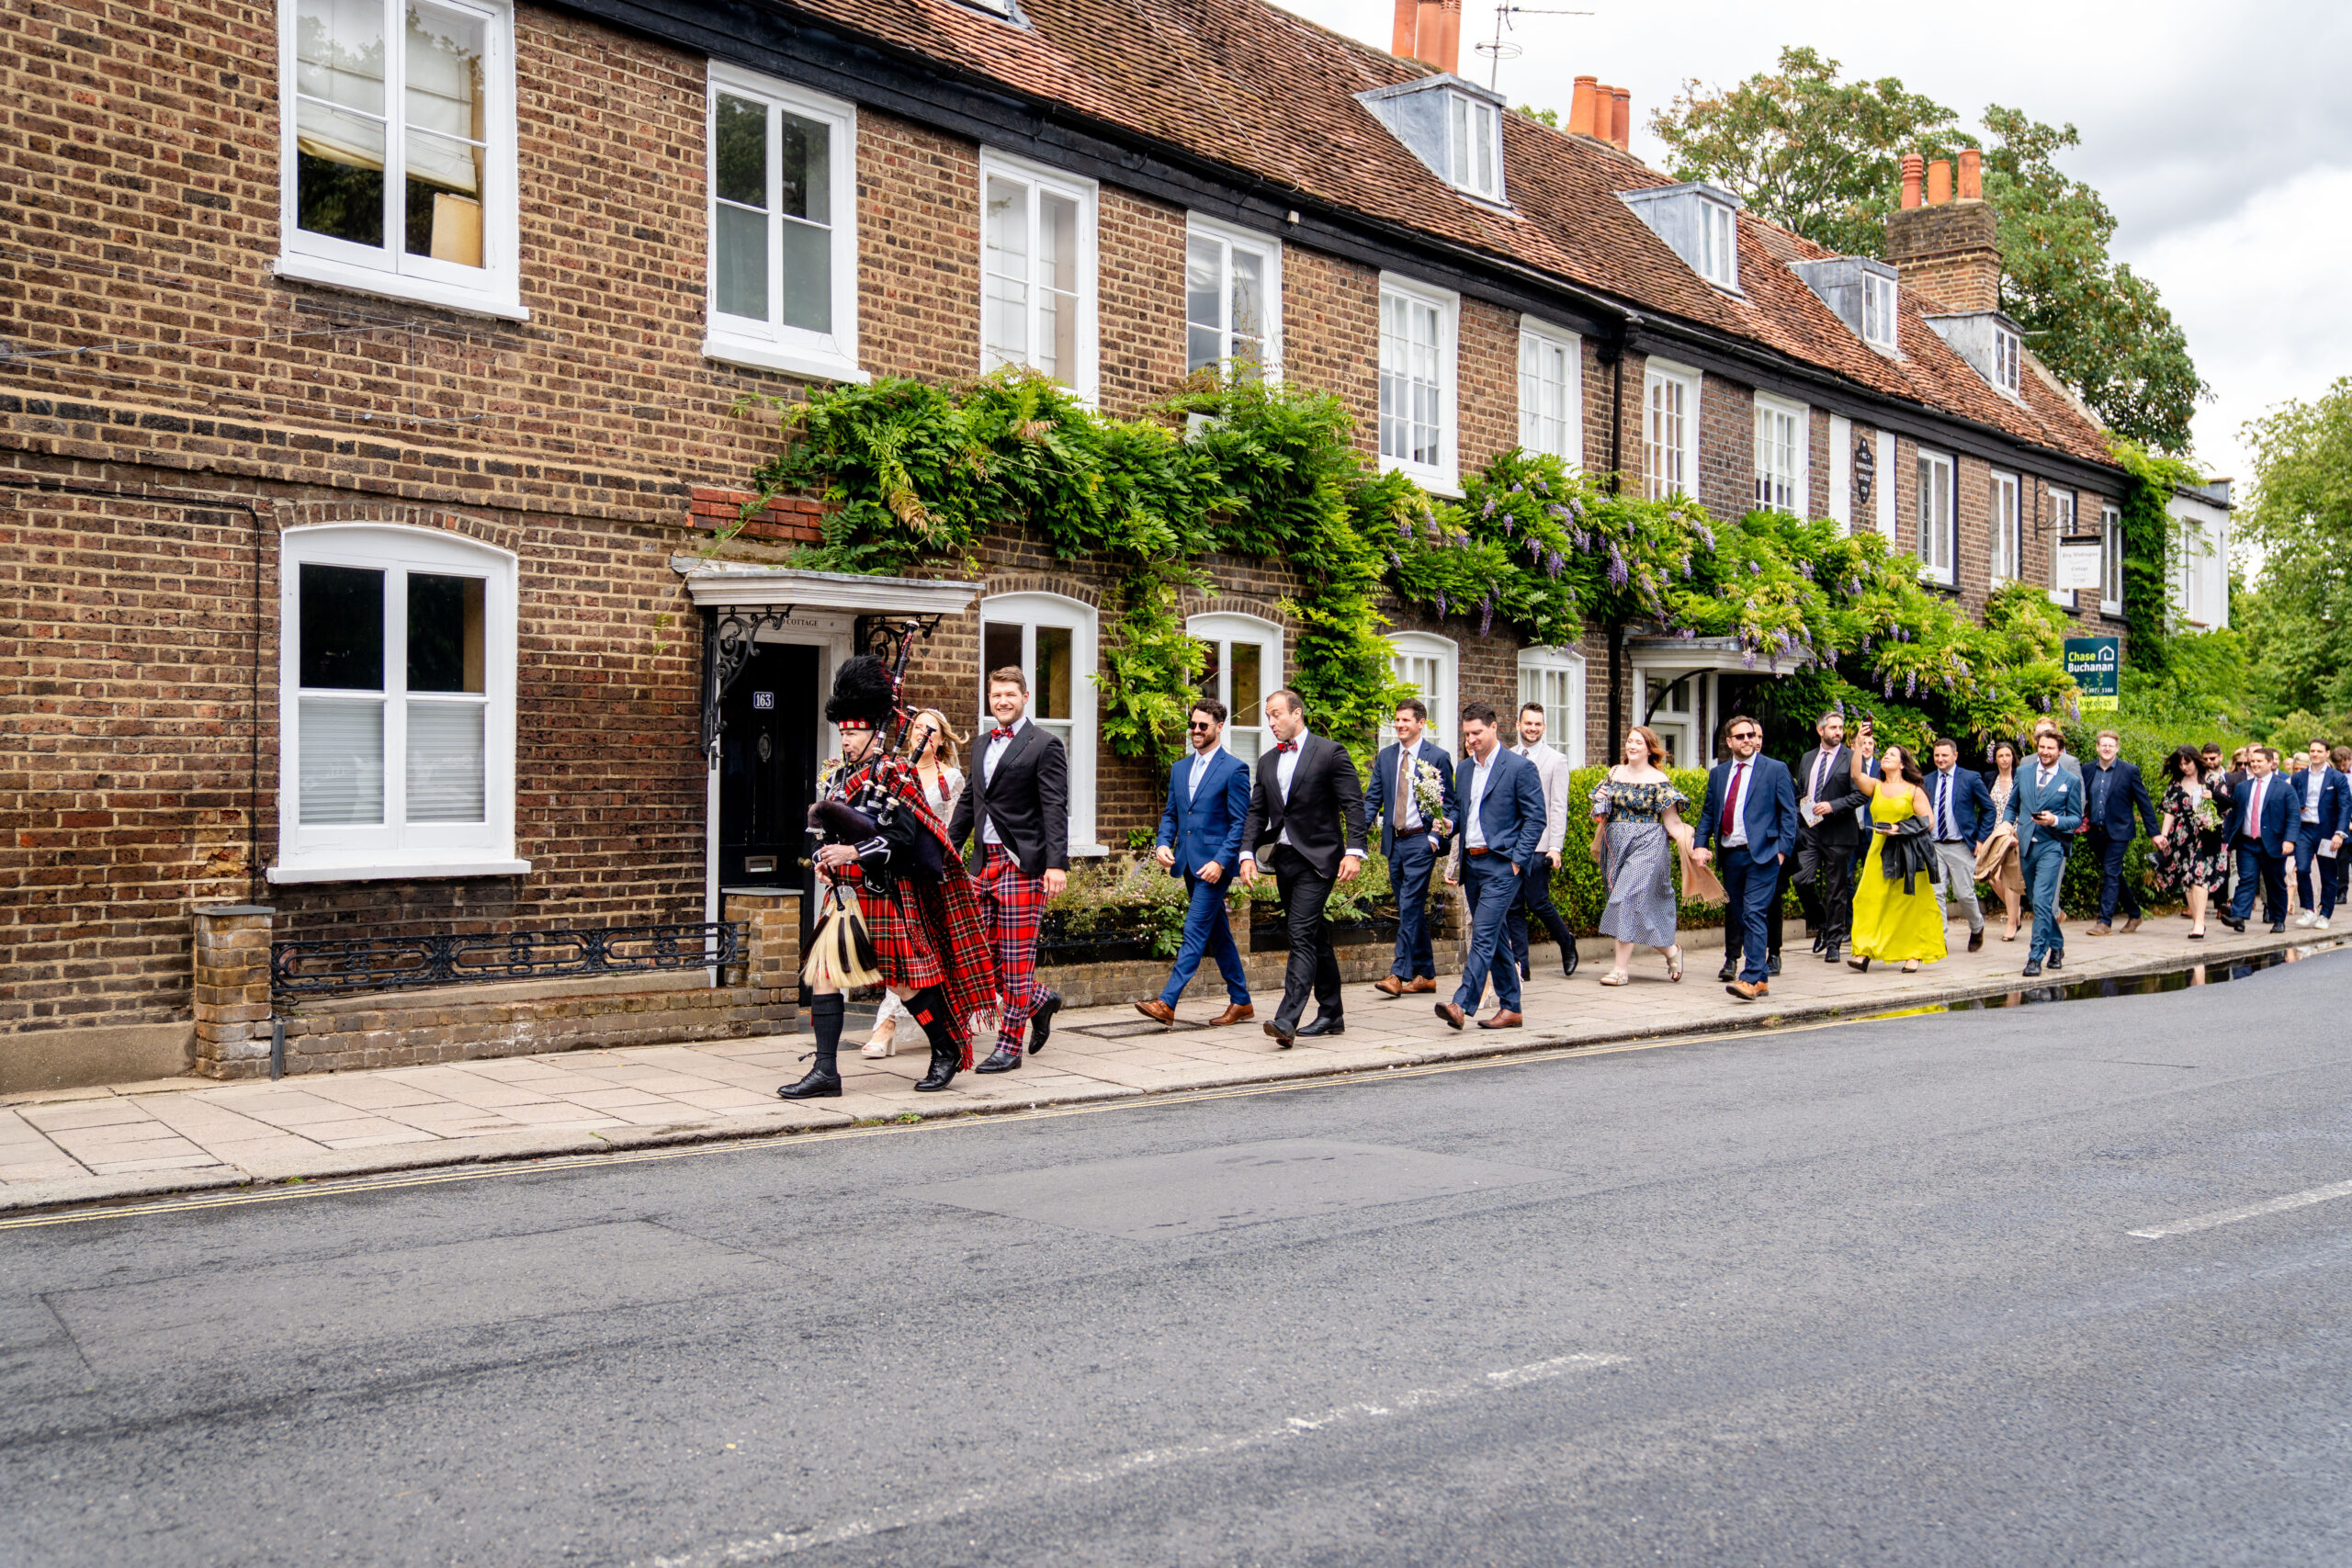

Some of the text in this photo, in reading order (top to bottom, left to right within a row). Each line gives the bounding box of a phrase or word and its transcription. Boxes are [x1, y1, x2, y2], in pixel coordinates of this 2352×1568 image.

[786, 619, 819, 627] COTTAGE
[2068, 651, 2097, 662] Chase
[2067, 661, 2114, 672] Buchanan
[756, 694, 771, 706] 163
